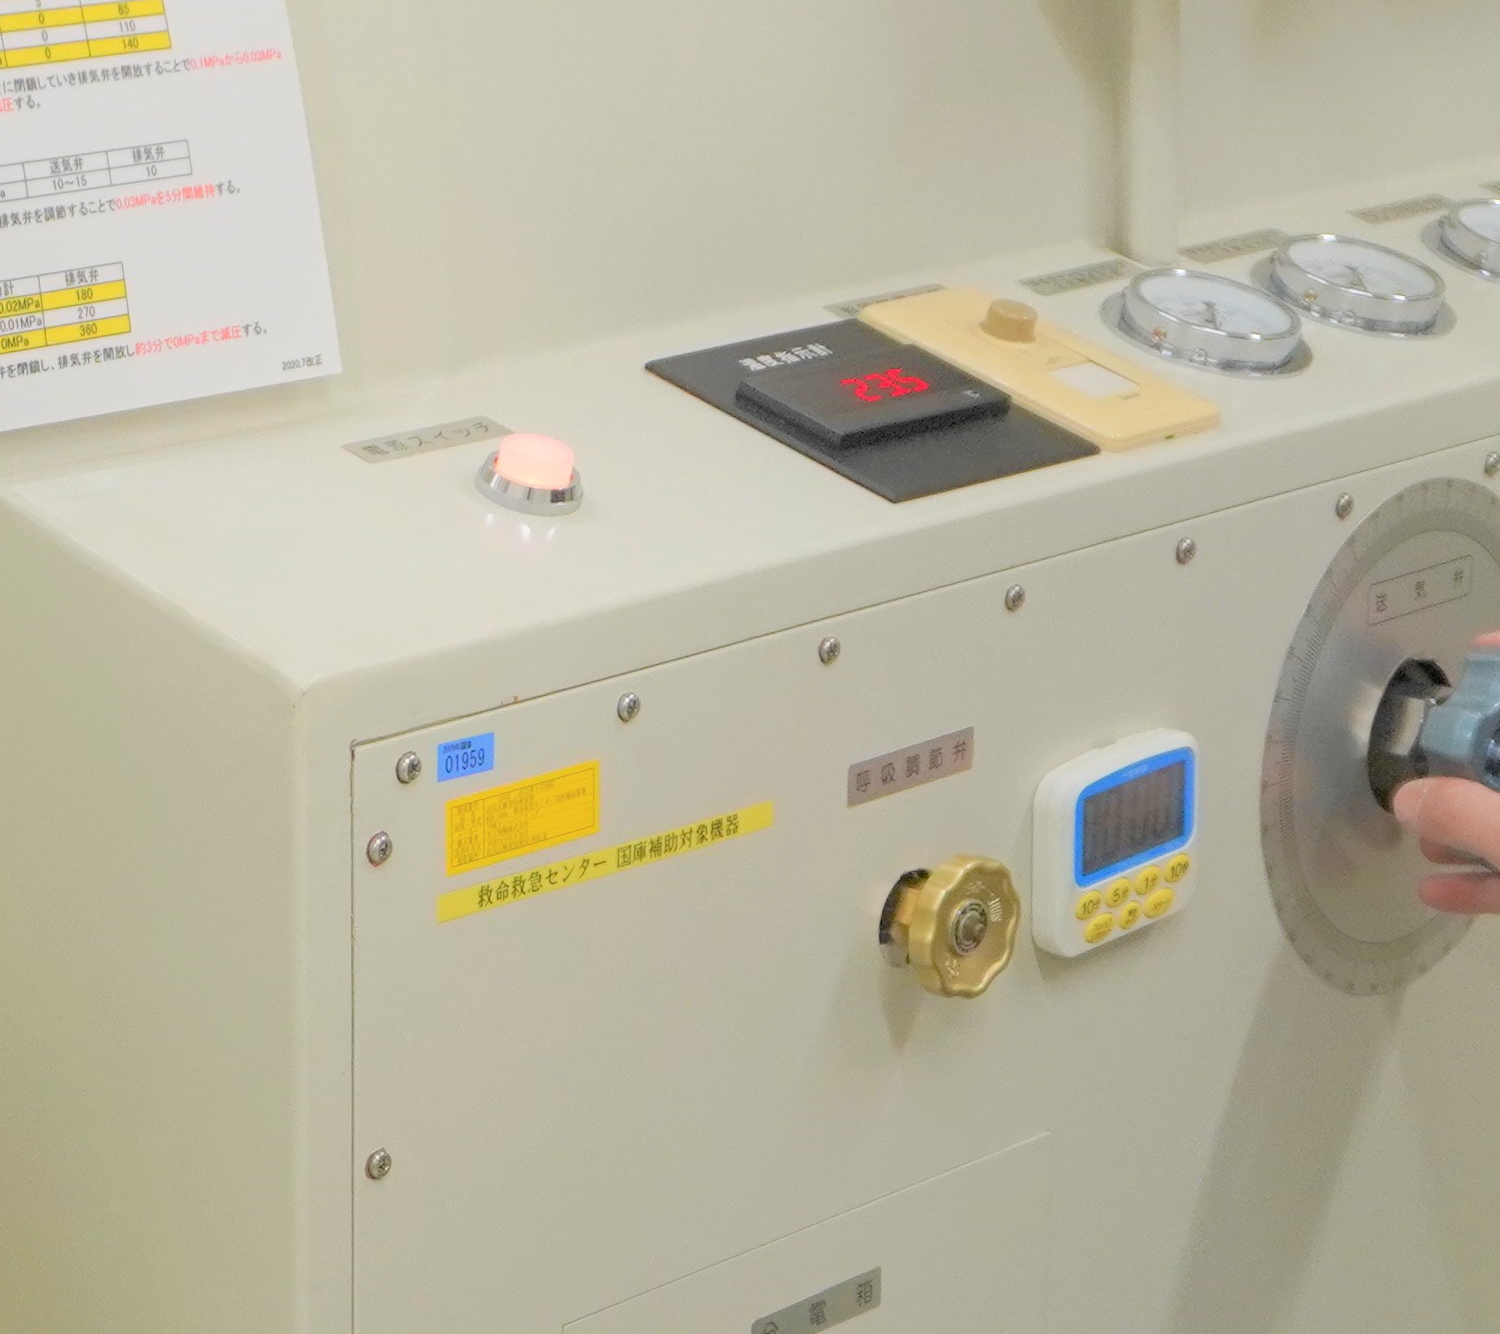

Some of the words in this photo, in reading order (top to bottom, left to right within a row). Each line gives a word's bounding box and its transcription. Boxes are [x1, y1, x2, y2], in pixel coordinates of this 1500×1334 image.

[119, 21, 136, 33] 110
[122, 37, 139, 50] 140
[132, 147, 166, 163] 排気弁
[50, 157, 84, 175] 送気弁
[146, 166, 158, 178] 10
[65, 269, 100, 286] 排気弁
[75, 287, 94, 301] 180
[77, 305, 96, 320] 270
[79, 322, 98, 337] 360
[445, 747, 486, 775] 01959
[855, 740, 968, 794] 呼吸調節弁
[477, 859, 608, 909] 救命救急センター
[616, 813, 740, 870] 国庫補助対象機器
